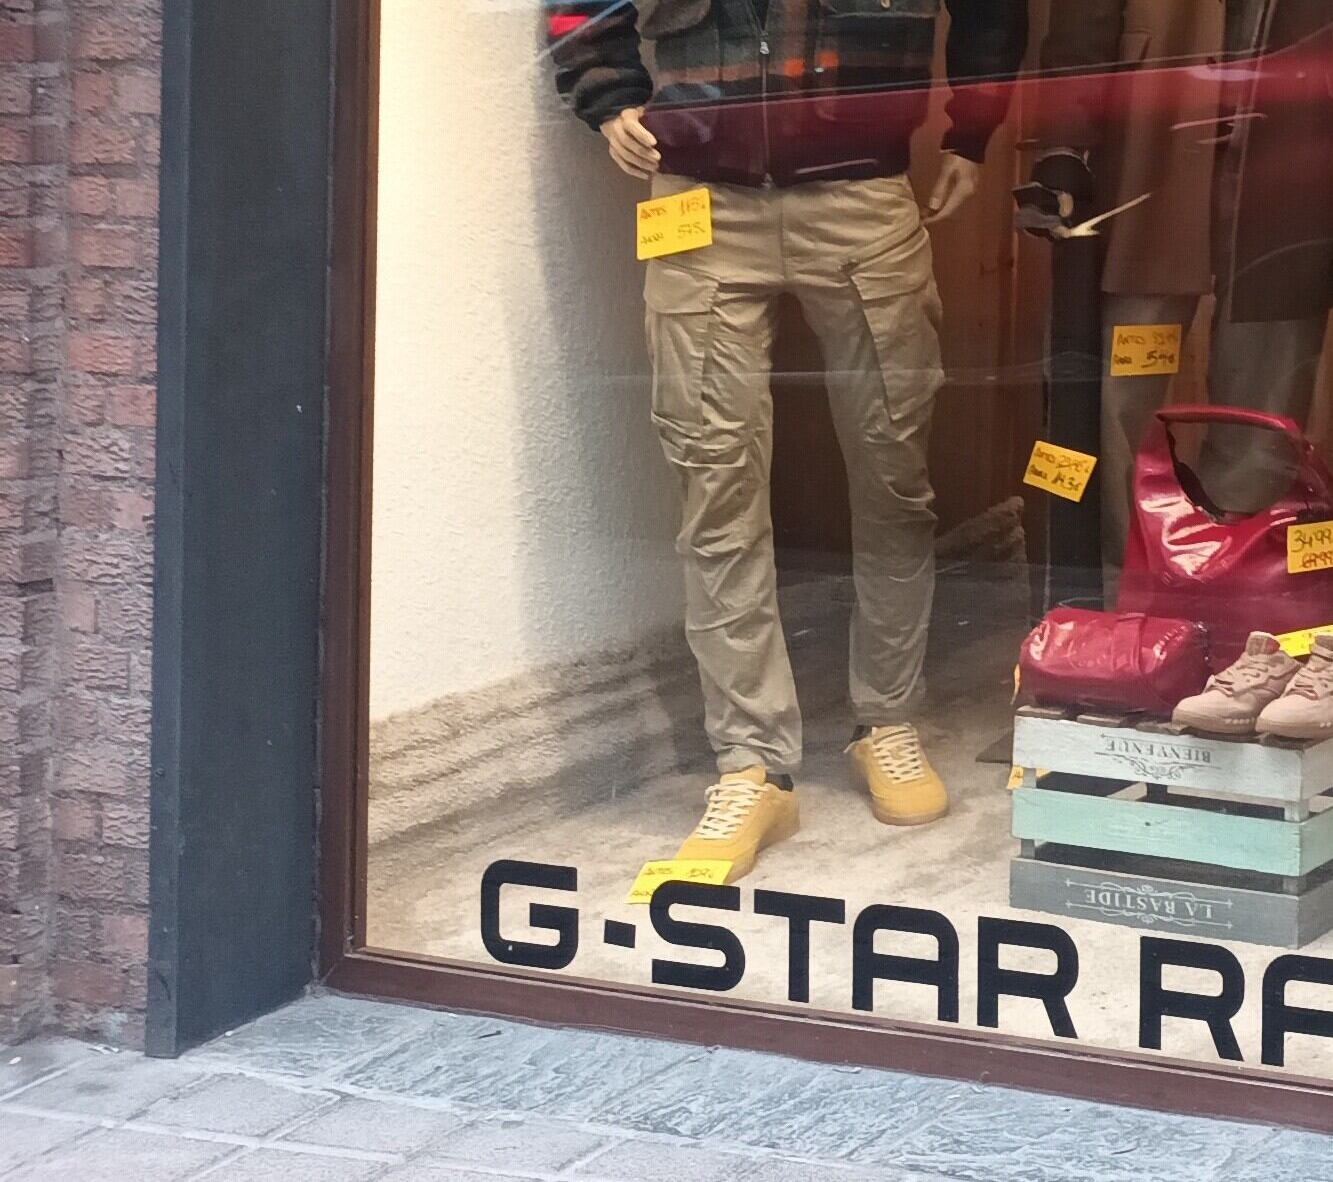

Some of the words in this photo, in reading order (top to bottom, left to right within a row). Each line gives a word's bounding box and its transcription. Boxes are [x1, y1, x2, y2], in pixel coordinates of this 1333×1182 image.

[1105, 738, 1212, 763] BIENVENUE
[1083, 888, 1176, 916] BASTIDE
[1185, 901, 1213, 919] LA
[479, 858, 1080, 1039] G-STAR
